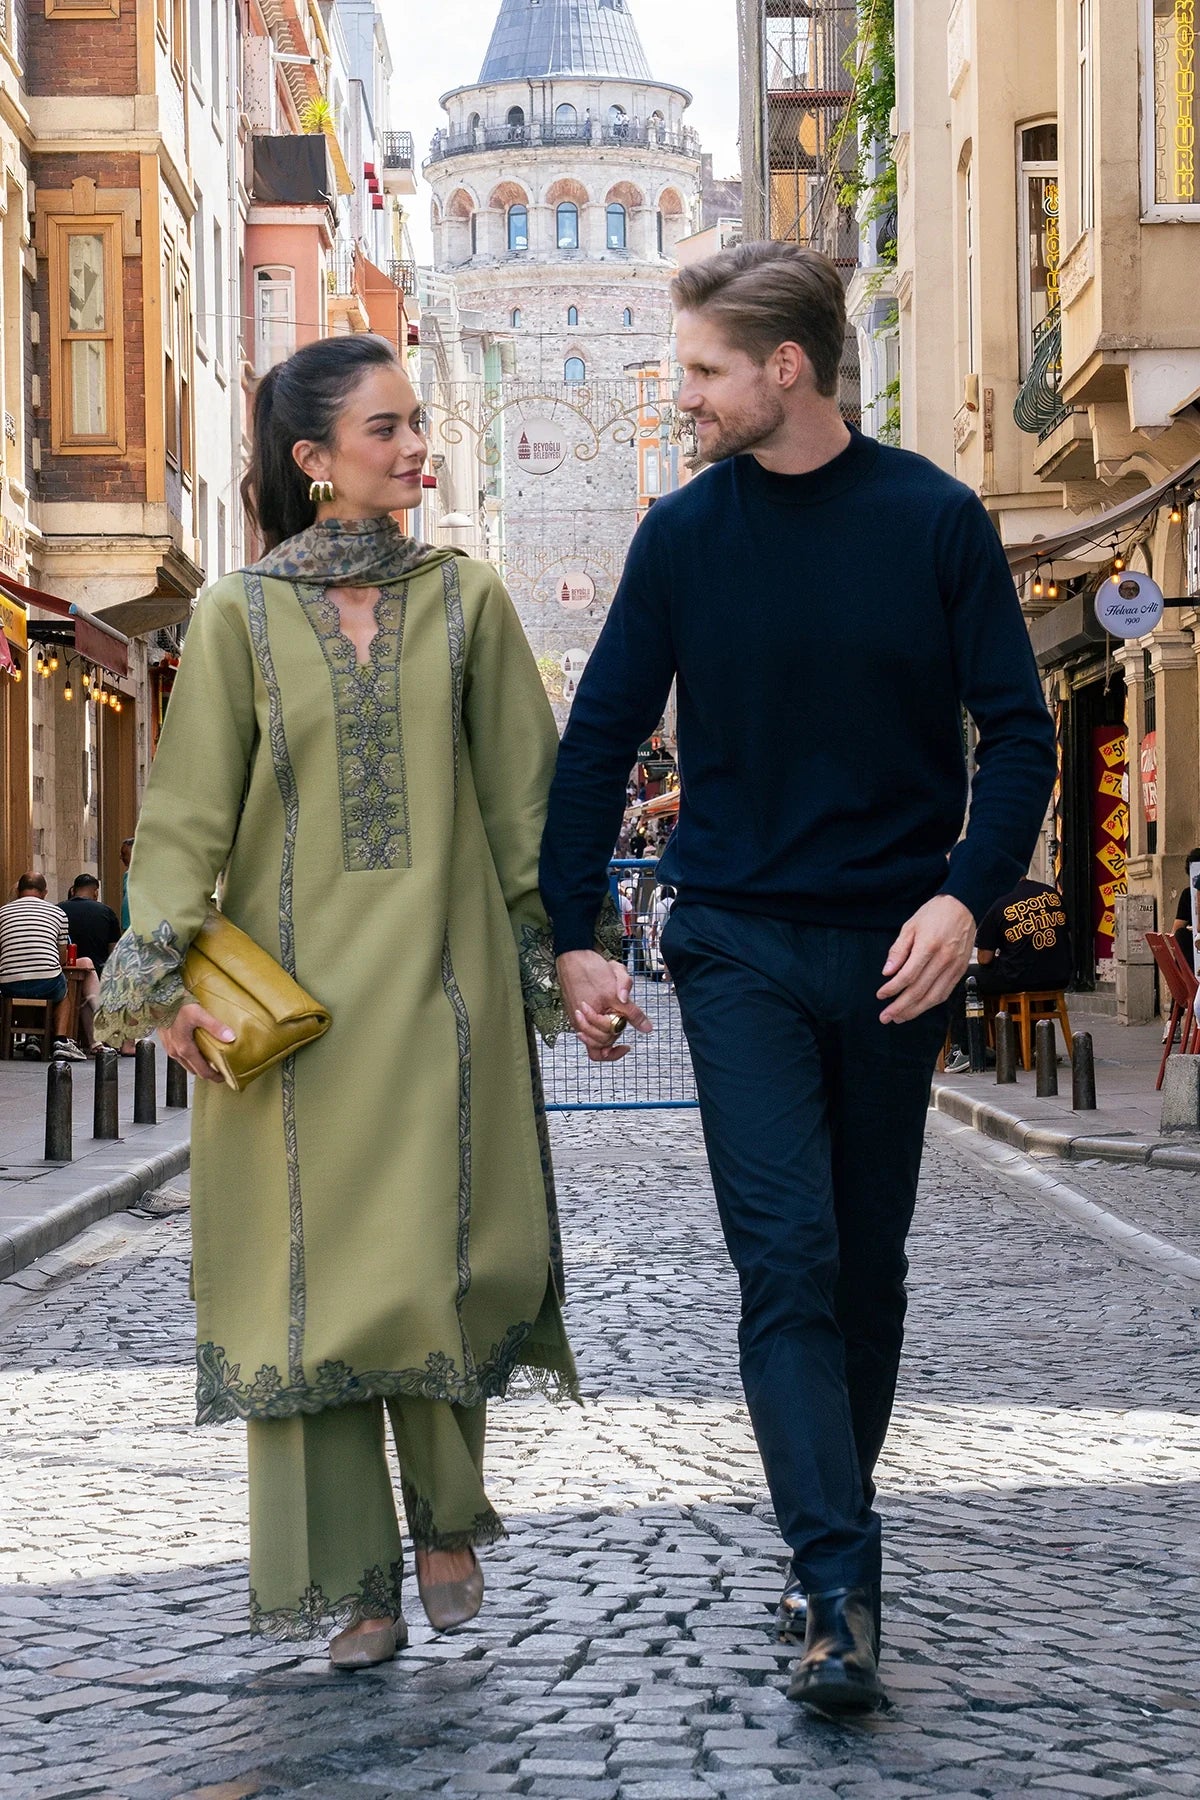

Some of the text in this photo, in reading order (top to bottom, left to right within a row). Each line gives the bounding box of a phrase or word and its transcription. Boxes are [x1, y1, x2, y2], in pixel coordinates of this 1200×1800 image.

[533, 441, 561, 452] BEYOĞLU
[1141, 602, 1159, 613] Ali
[1125, 617, 1141, 626] 1900
[1004, 892, 1061, 921] sports
[1005, 909, 1066, 942] archive
[1033, 928, 1056, 950] 08
